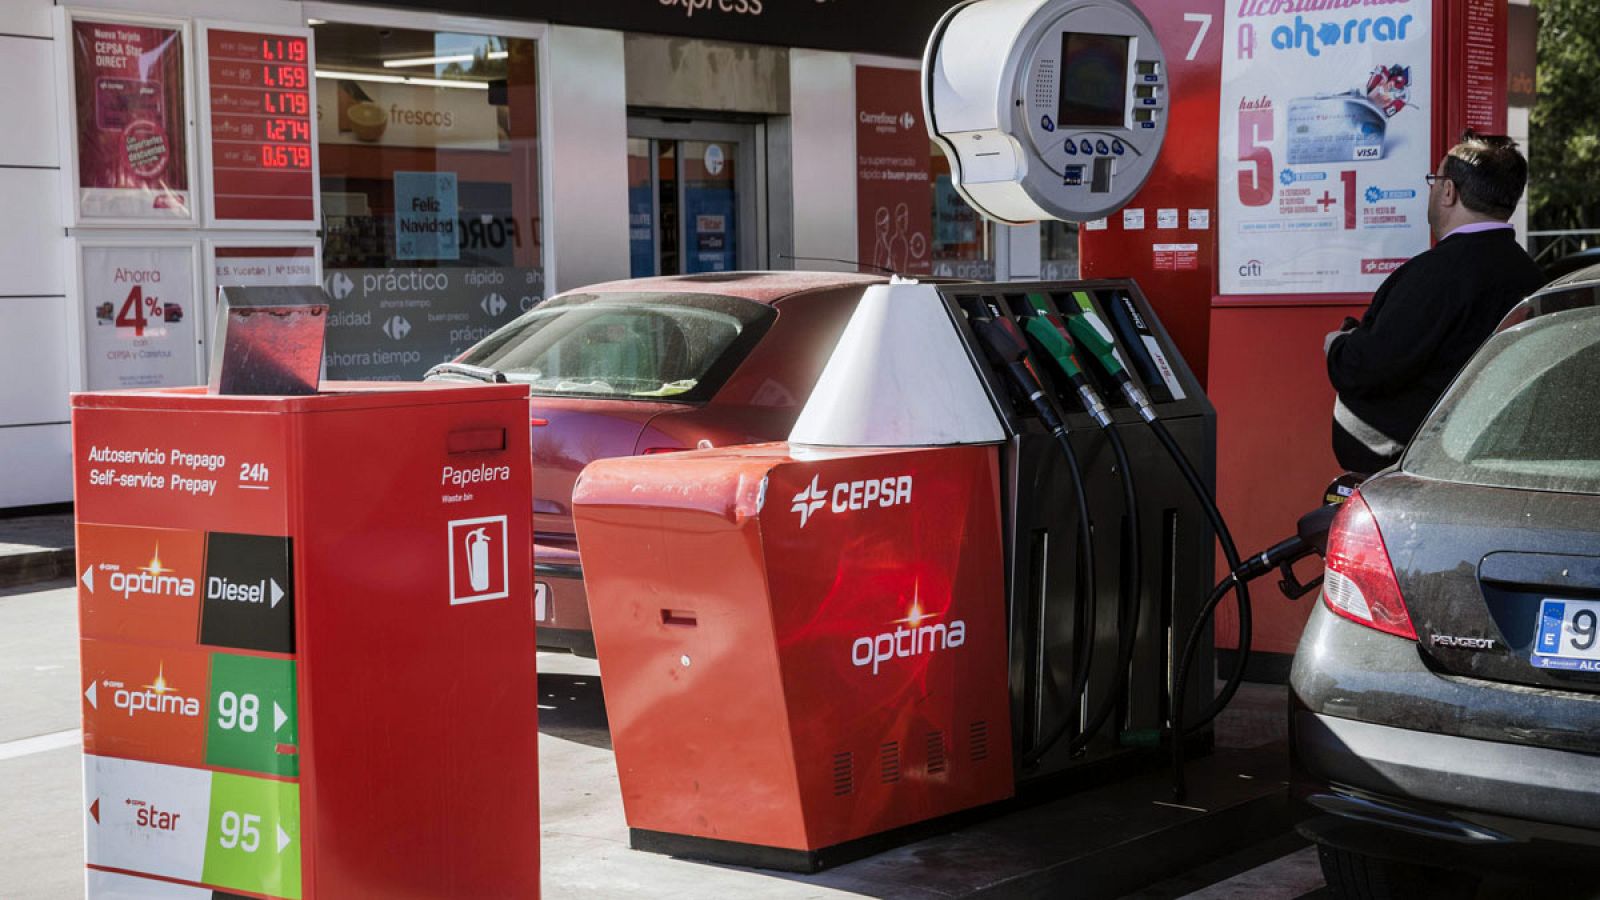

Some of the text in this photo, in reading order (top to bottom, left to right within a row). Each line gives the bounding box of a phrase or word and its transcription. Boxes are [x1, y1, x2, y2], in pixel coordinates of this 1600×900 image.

[96, 42, 123, 54] CEPSA
[1184, 13, 1212, 60] 7
[1238, 23, 1255, 59] A
[96, 55, 127, 68] DIRECT
[390, 104, 453, 128] frescos
[262, 144, 311, 168] 0.679
[1237, 111, 1274, 207] 5
[1356, 148, 1379, 158] VISA
[411, 197, 442, 213] Feliz
[400, 217, 454, 234] Navidad
[114, 267, 161, 283] Ahorra
[464, 269, 505, 288] rápido
[1238, 262, 1262, 277] citi
[1378, 262, 1403, 271] CEPS
[363, 268, 449, 298] práctico
[326, 348, 420, 367] ahorra tiempo
[88, 445, 225, 471] Autoservicio Prepago
[90, 468, 217, 497] Self-service Prepay
[239, 462, 269, 482] 24h
[442, 463, 510, 489] Papelera
[831, 475, 913, 513] CEPSA
[110, 571, 195, 600] optima
[207, 576, 265, 605] Diesel
[851, 618, 966, 675] optima
[1430, 634, 1496, 650] PEUGEOT
[1544, 632, 1556, 646] E
[114, 689, 200, 717] optima
[217, 692, 259, 732] 98
[136, 805, 180, 832] star
[219, 810, 262, 853] 95
